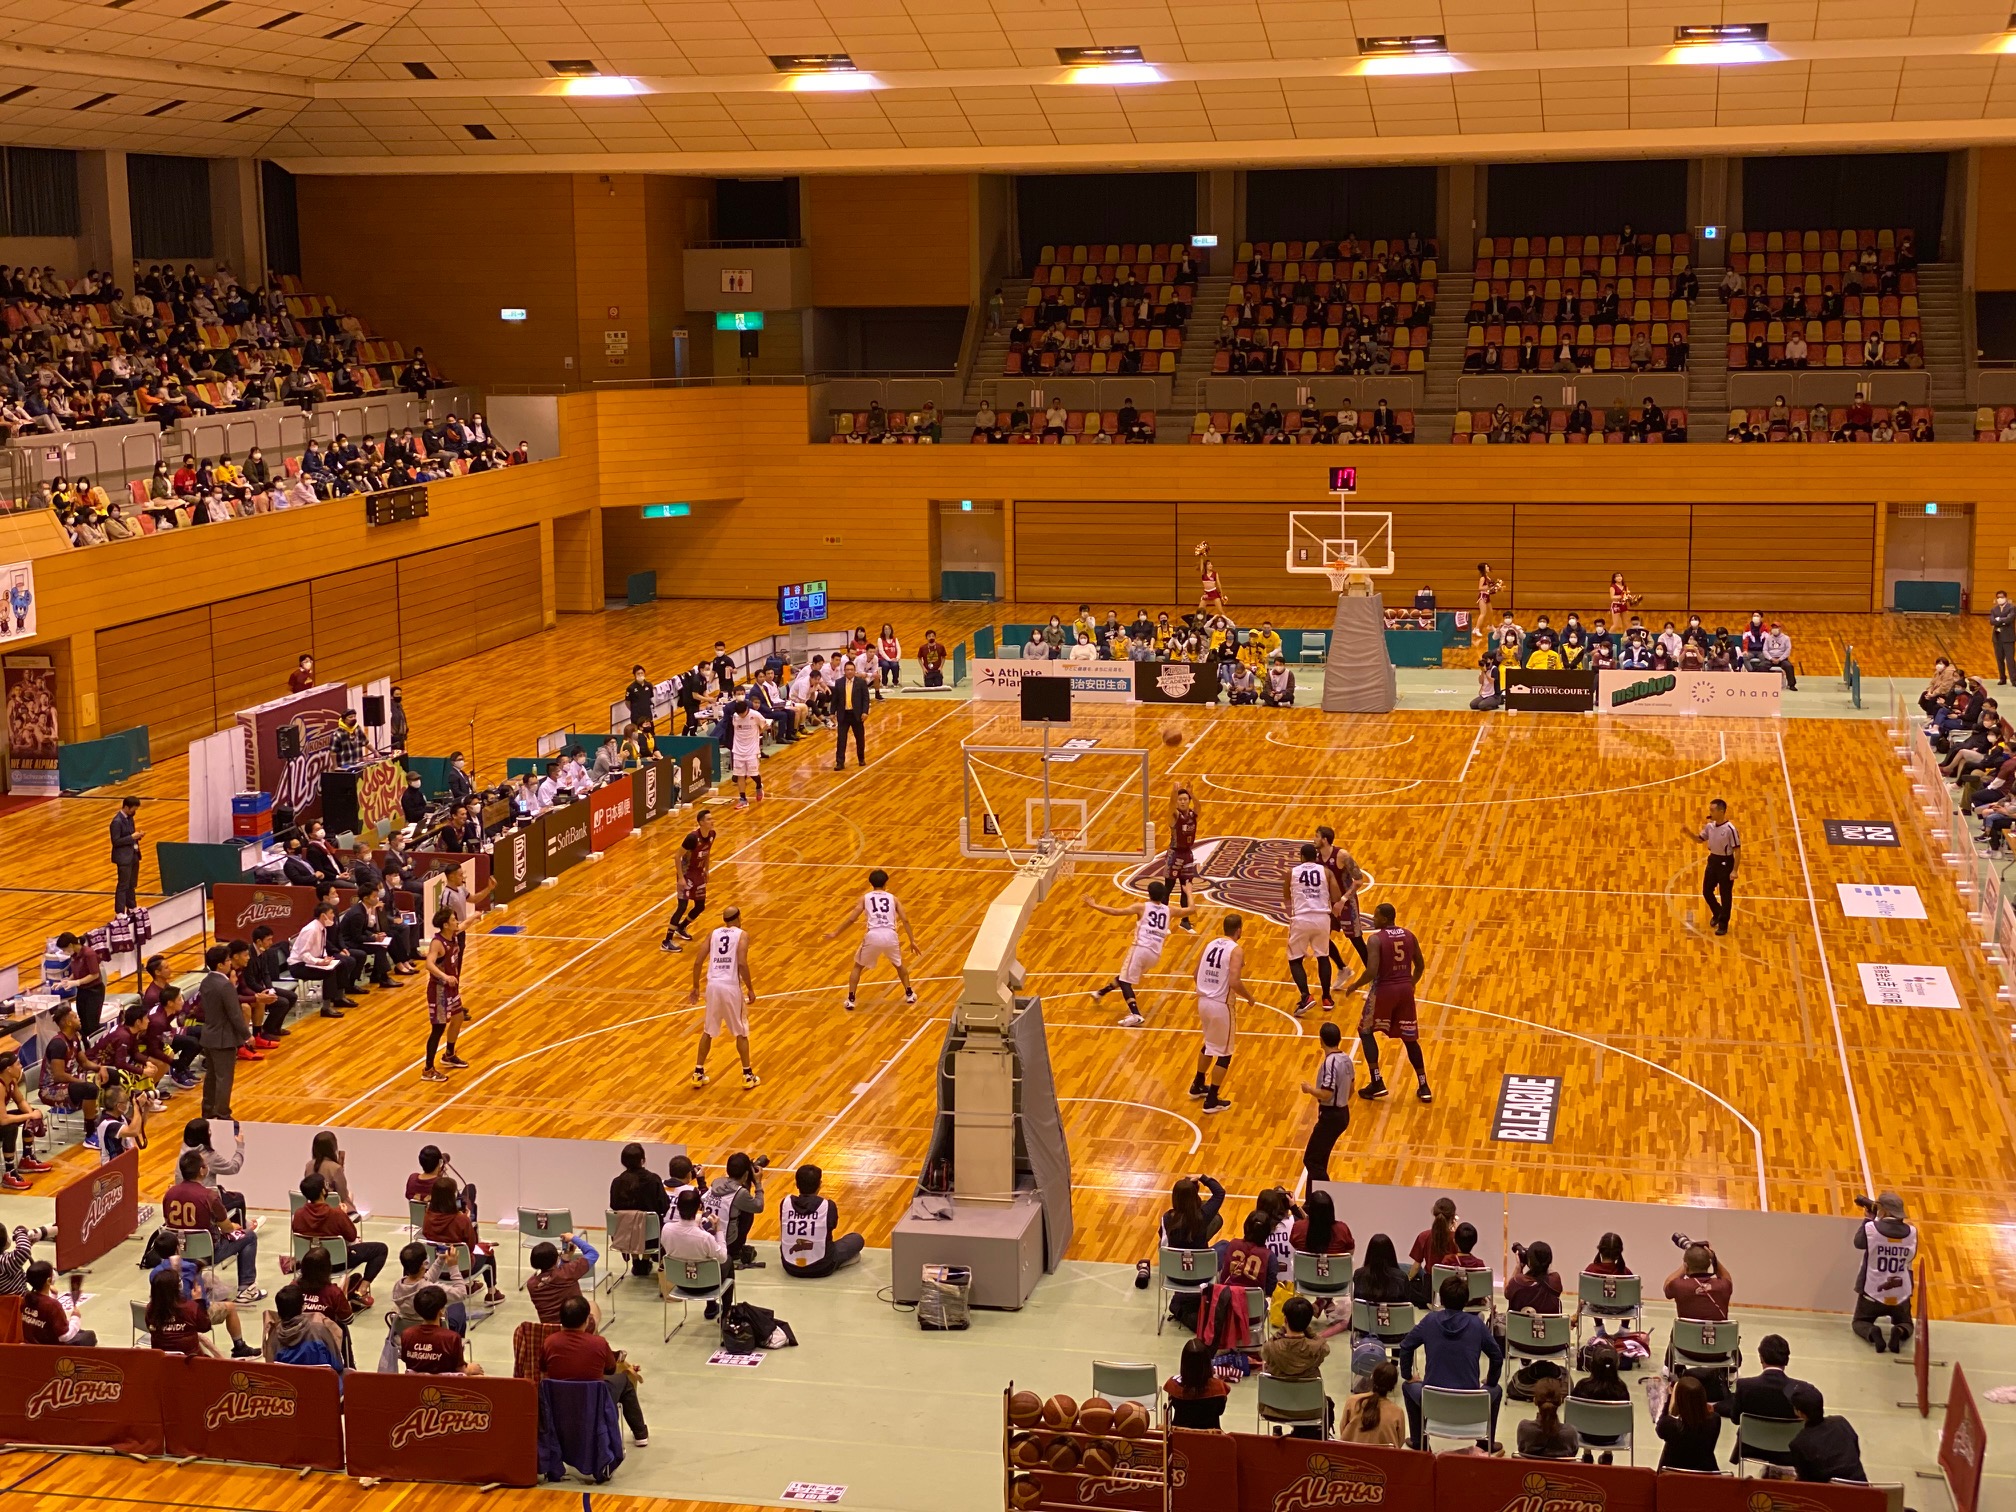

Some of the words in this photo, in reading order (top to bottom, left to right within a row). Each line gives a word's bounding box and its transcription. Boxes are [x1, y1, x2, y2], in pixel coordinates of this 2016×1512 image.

[789, 598, 799, 609] 66
[998, 668, 1042, 677] Athlete
[1726, 688, 1779, 698] Ohana
[605, 798, 631, 825] 日本郵便
[557, 822, 588, 851] SoftBank
[1299, 870, 1321, 887] 40
[870, 896, 890, 913] 13
[237, 903, 292, 928] ALPHAS
[1148, 910, 1167, 930] 30
[718, 935, 730, 955] 3
[1393, 940, 1405, 962] 5
[1206, 946, 1225, 969] 41
[1498, 1077, 1555, 1141] B.LEAGUE
[82, 1185, 123, 1243] ALPHAS
[169, 1200, 197, 1227] 20
[539, 1222, 546, 1230] 7
[787, 1220, 816, 1236] 021
[1877, 1245, 1910, 1257] PHOTO
[1181, 1262, 1193, 1271] 11
[1229, 1250, 1263, 1281] 20
[1317, 1268, 1330, 1277] 13
[1877, 1256, 1907, 1274] 002
[686, 1271, 698, 1280] 10
[1603, 1290, 1617, 1298] 17
[24, 1307, 39, 1318] CLUB
[1377, 1318, 1390, 1327] 14
[1531, 1330, 1545, 1339] 16
[1701, 1336, 1715, 1345] 18
[406, 1350, 442, 1361] BURGUNDY
[413, 1343, 433, 1351] CLUB
[27, 1378, 122, 1419] ALPHAS
[206, 1392, 296, 1429] ALPHAS
[391, 1407, 490, 1449] ALPHAS
[1273, 1476, 1385, 1512] ALPHAS
